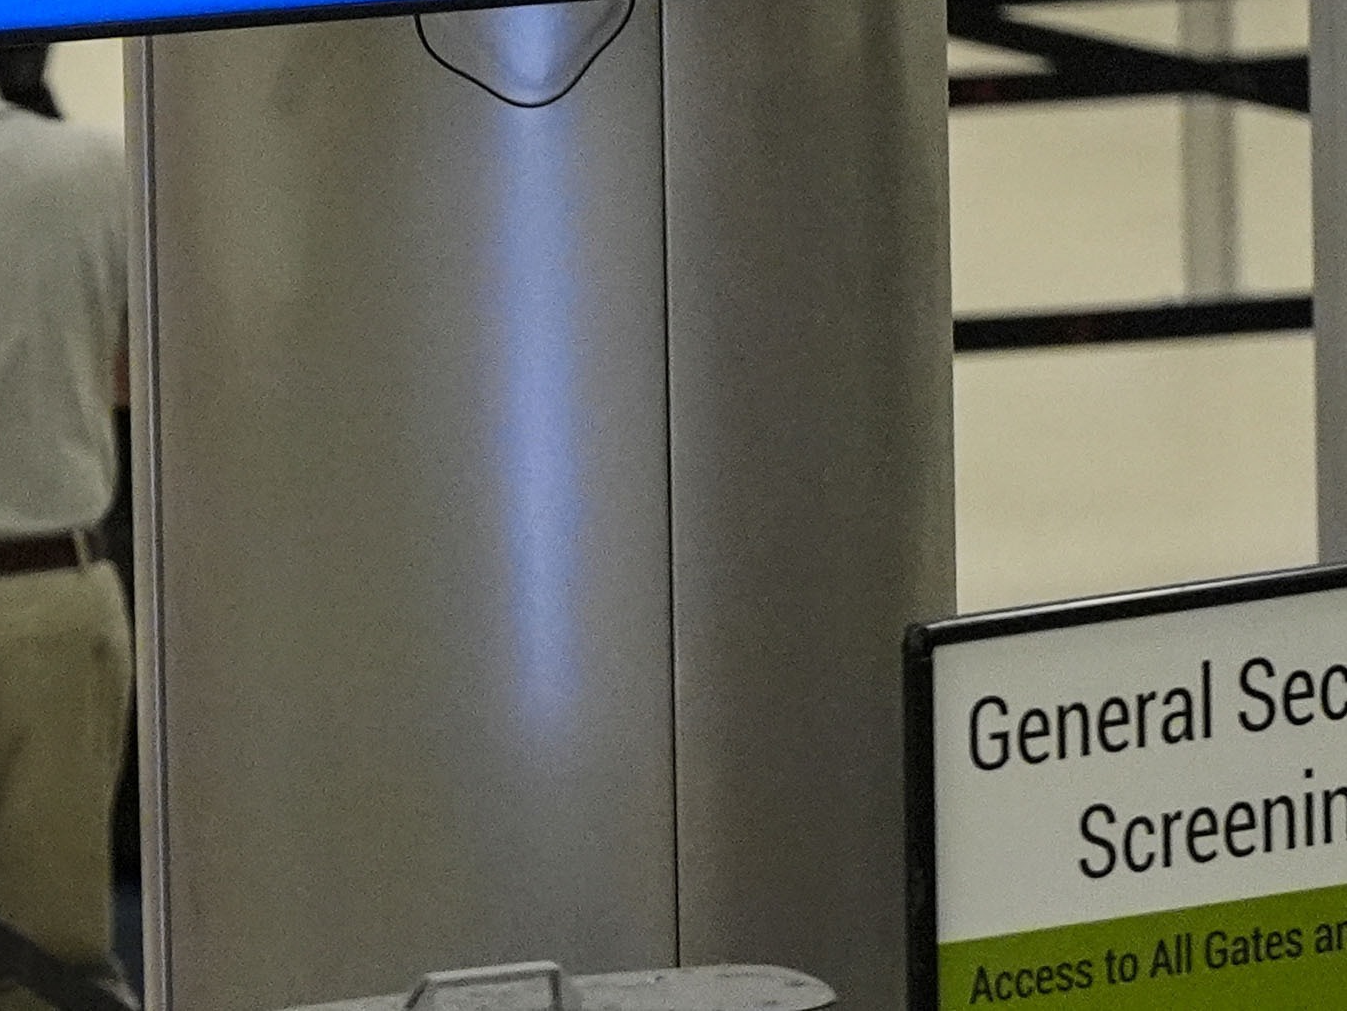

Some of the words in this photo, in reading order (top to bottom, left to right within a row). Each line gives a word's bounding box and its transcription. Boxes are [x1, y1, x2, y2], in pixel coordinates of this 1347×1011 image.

[969, 660, 1212, 771] General
[1238, 657, 1347, 732] Sec
[970, 958, 1094, 1005] Access
[1105, 948, 1138, 985] to
[1149, 932, 1192, 978] All
[1205, 927, 1303, 970] Gates
